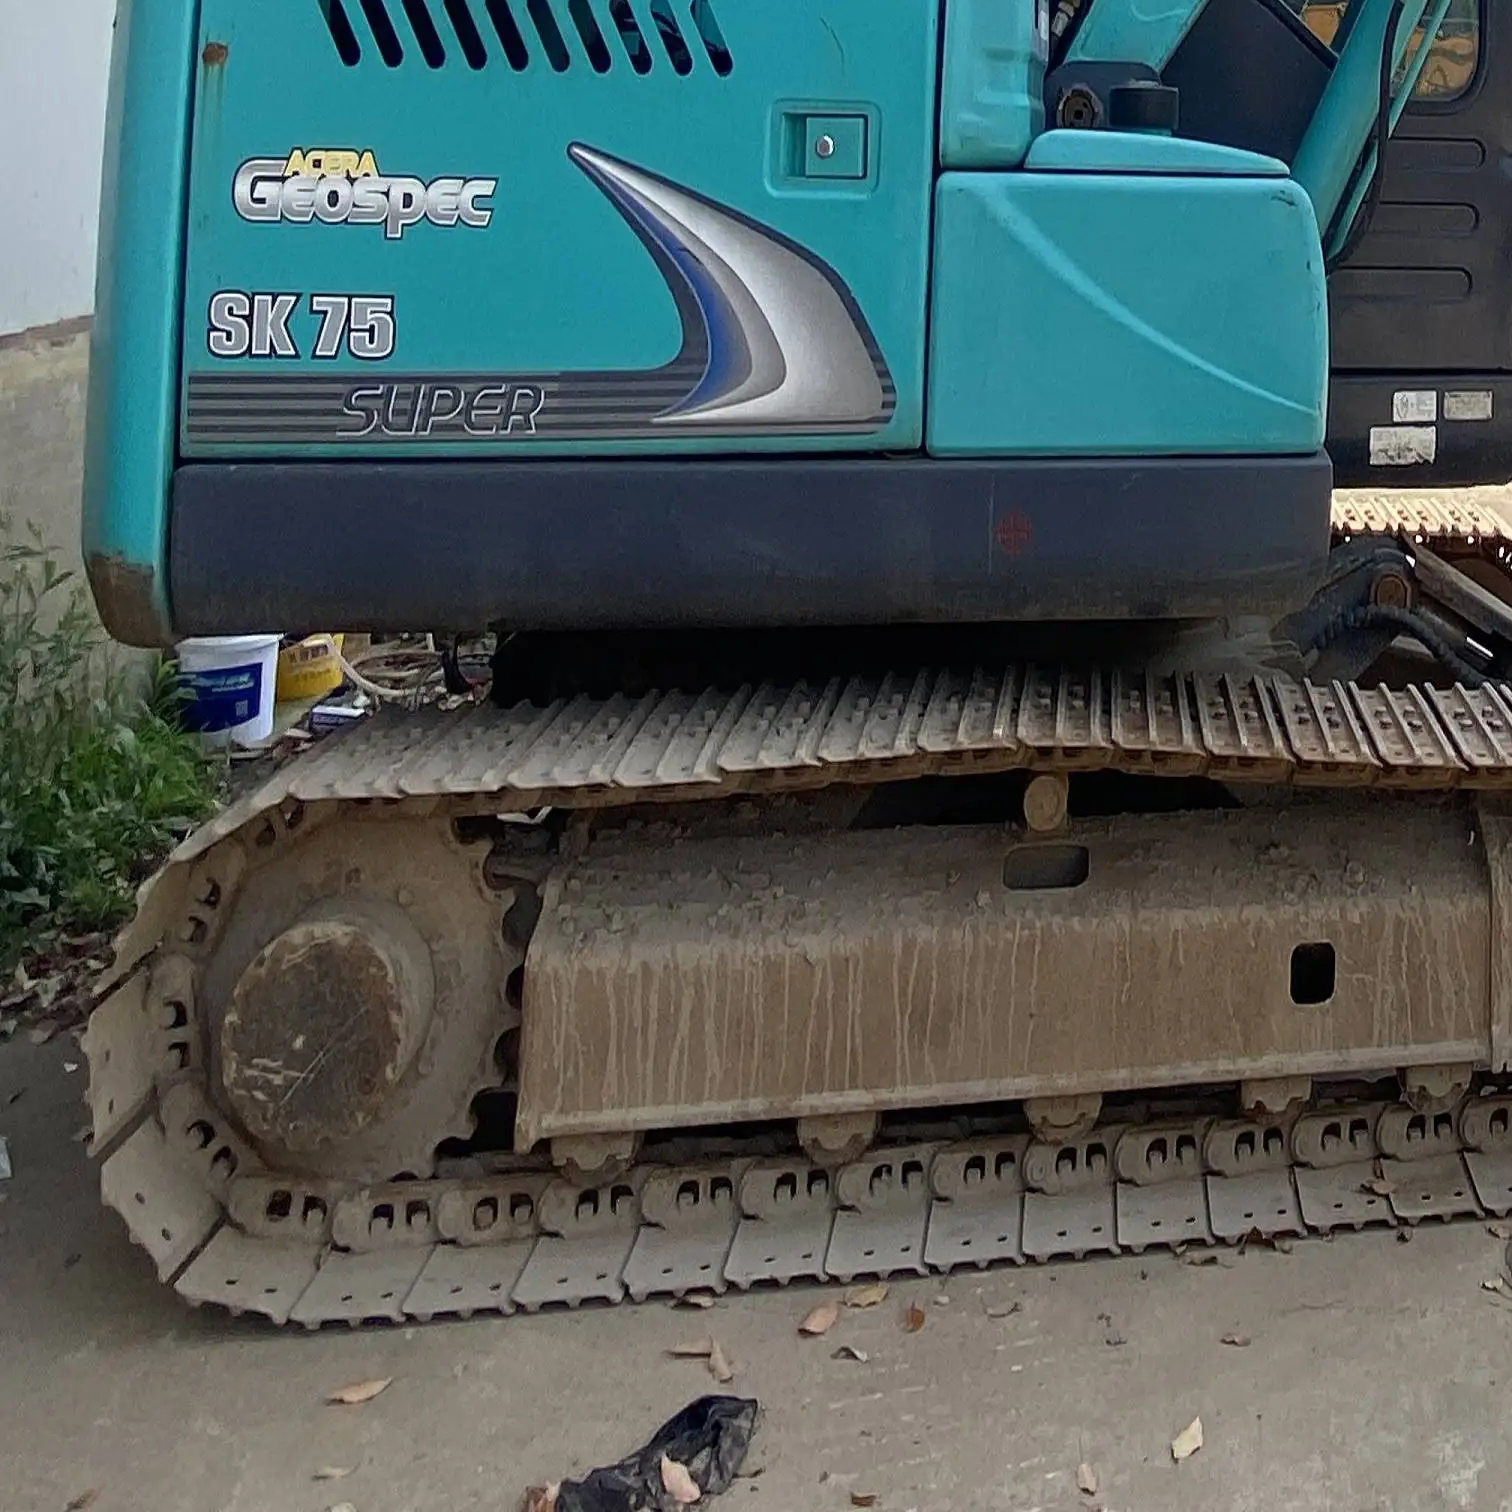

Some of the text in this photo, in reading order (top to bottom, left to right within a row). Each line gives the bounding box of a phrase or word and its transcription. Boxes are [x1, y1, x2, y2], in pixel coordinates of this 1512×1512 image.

[282, 148, 380, 178] ACERA
[208, 291, 395, 360] SK 75
[336, 384, 546, 437] SUPER
